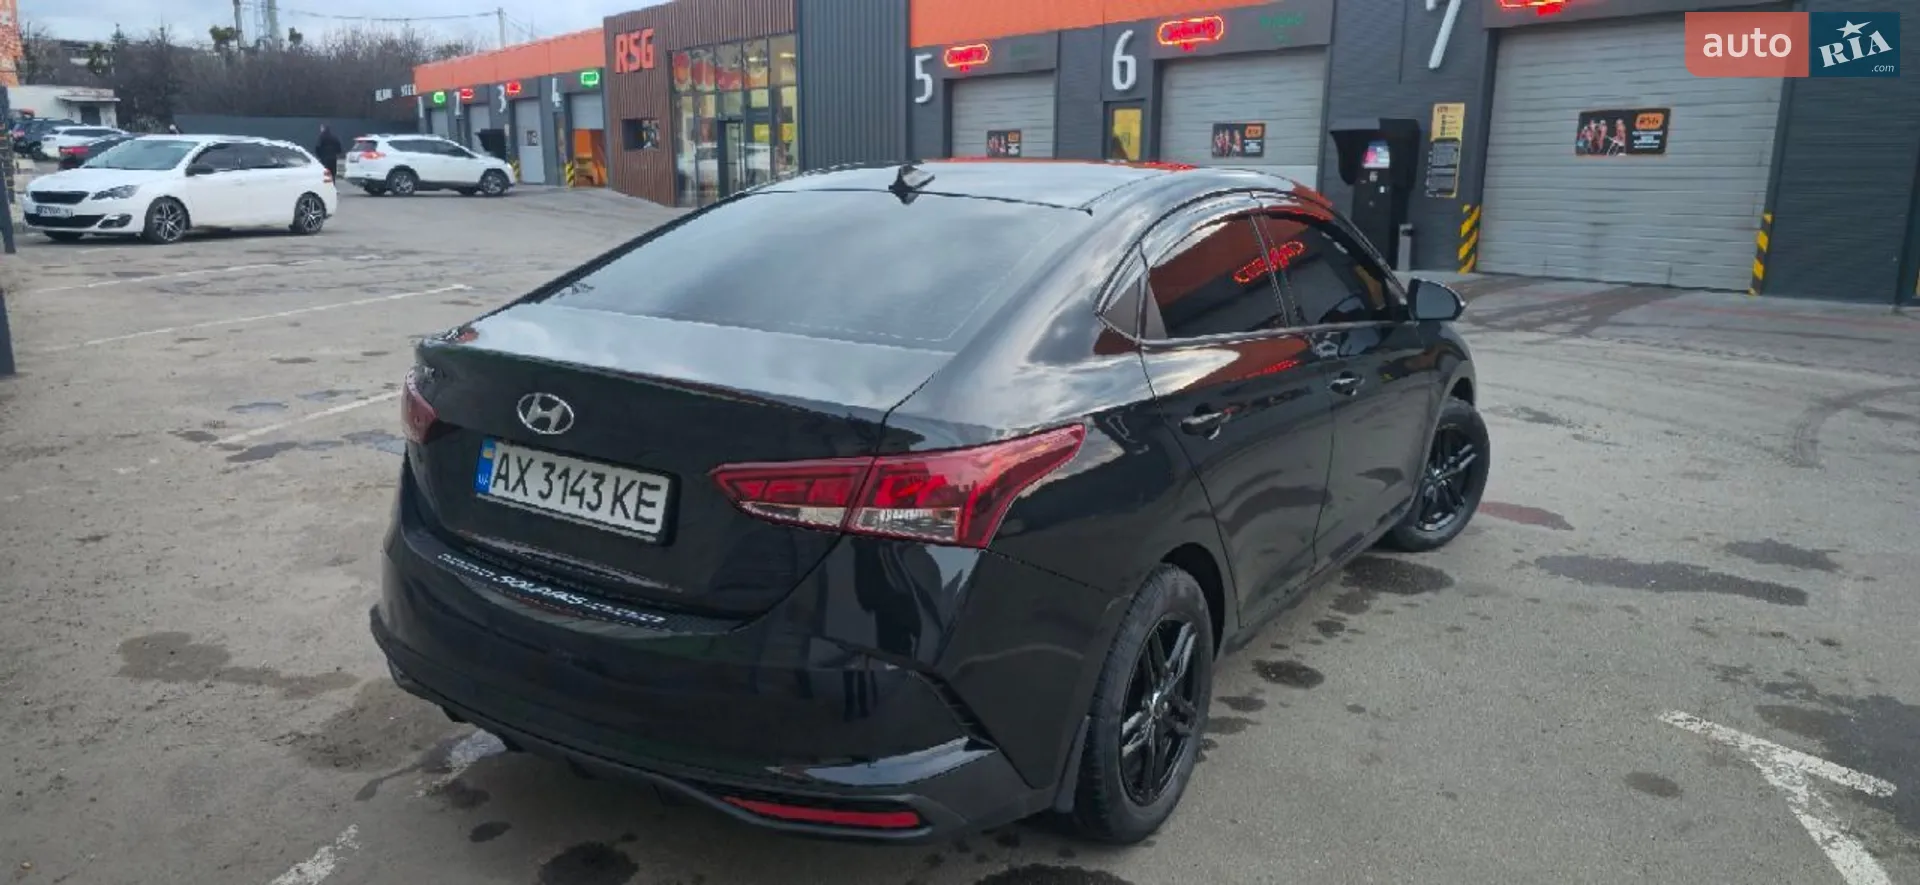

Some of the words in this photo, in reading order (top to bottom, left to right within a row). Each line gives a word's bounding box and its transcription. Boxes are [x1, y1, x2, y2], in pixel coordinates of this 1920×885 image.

[615, 28, 654, 73] RSG
[914, 53, 933, 104] 5
[1112, 29, 1137, 91] 6
[492, 452, 534, 497] AX
[537, 462, 606, 512] 3143
[610, 475, 661, 525] KE
